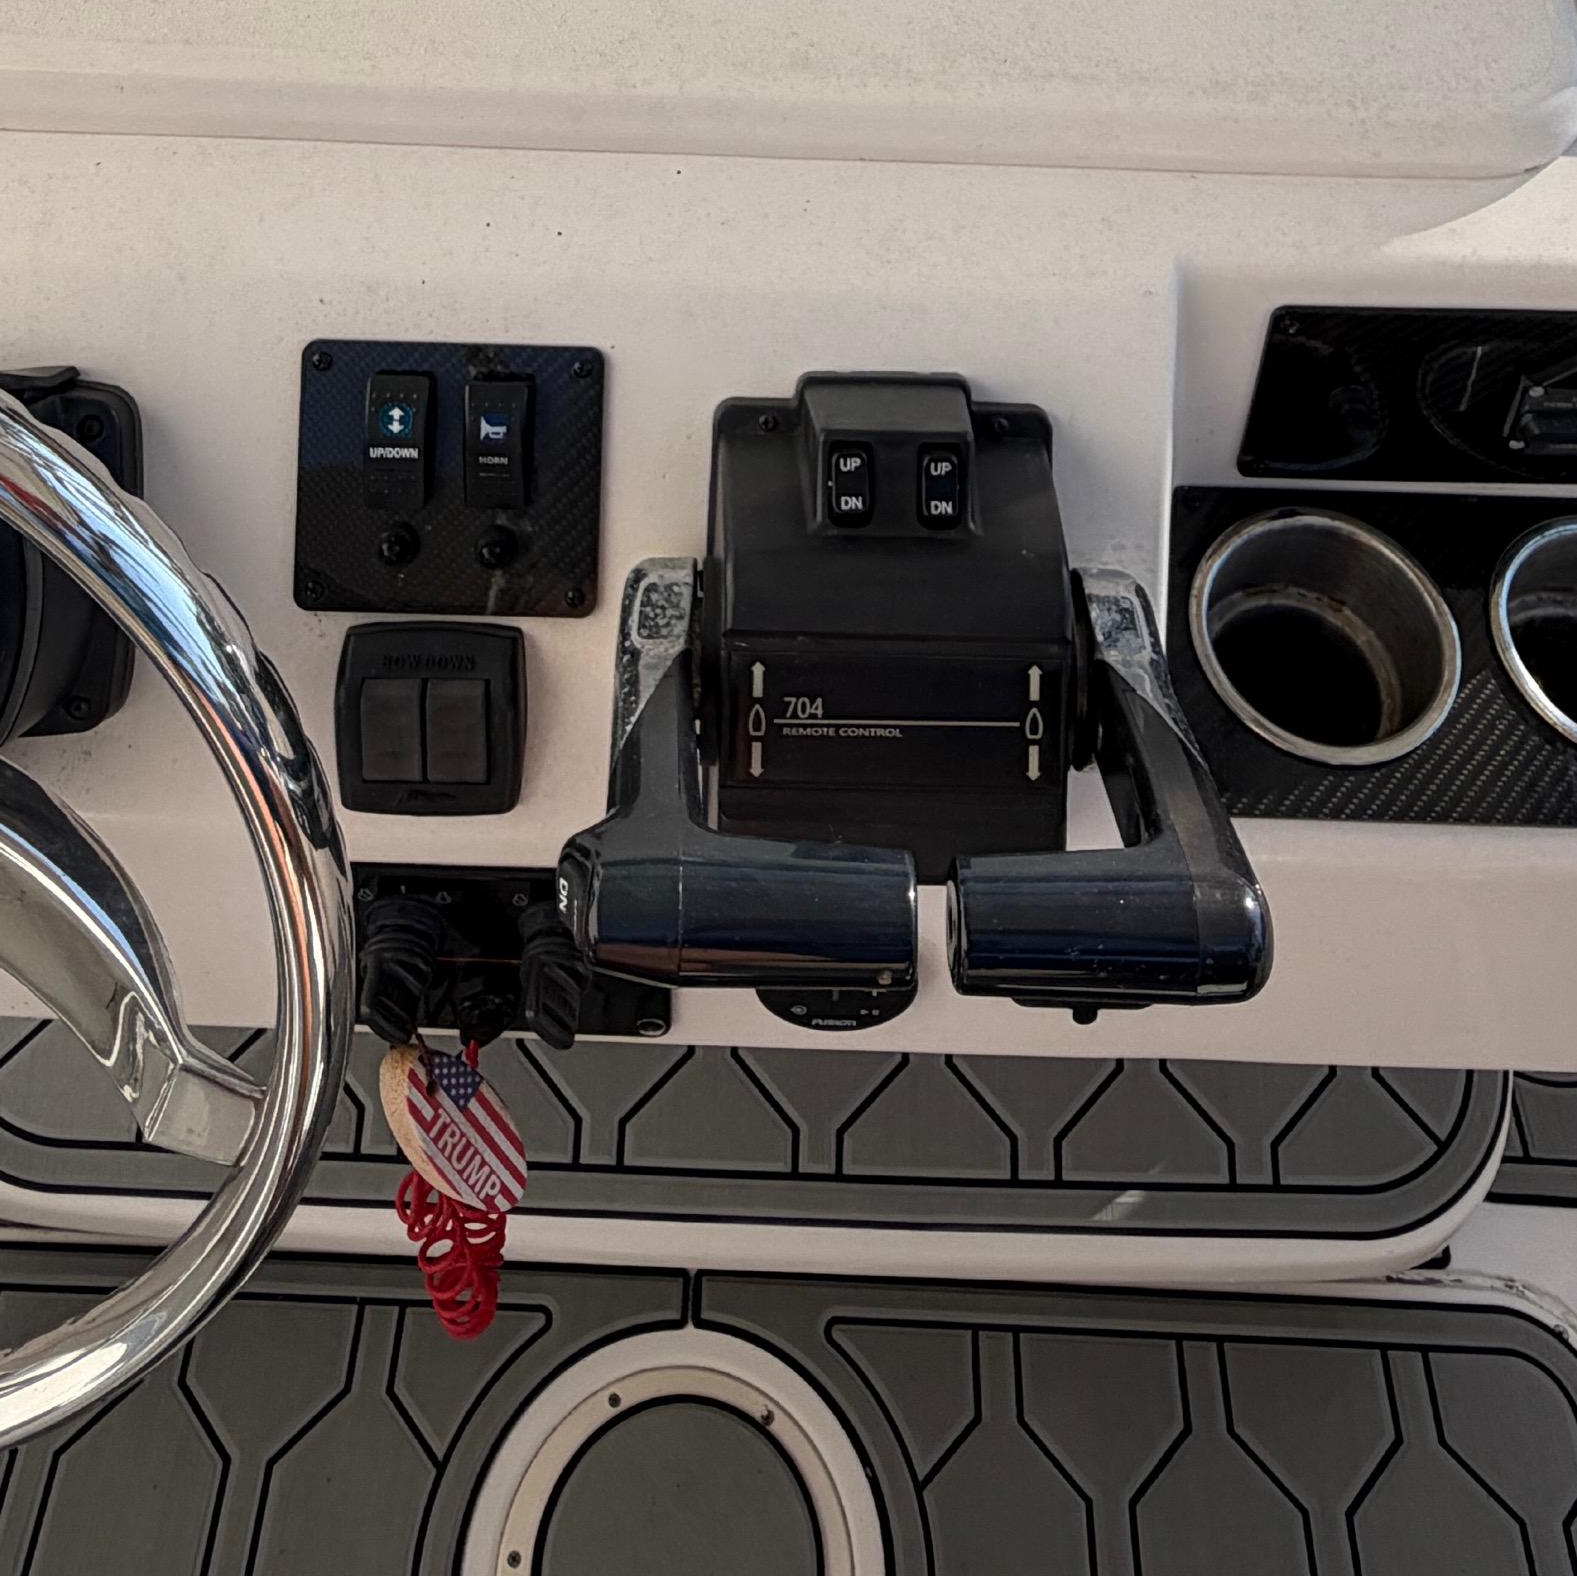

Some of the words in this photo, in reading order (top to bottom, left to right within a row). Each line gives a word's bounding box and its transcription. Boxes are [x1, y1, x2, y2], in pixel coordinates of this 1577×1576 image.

[369, 447, 419, 459] UP/DOWN
[478, 456, 508, 466] HORN
[839, 457, 861, 472] UP
[930, 461, 952, 477] UP
[840, 496, 863, 511] DN
[930, 500, 953, 515] DN
[783, 697, 824, 719] 704
[782, 727, 836, 738] REMOTE
[839, 727, 903, 738] CONTROL
[558, 876, 569, 914] DN
[428, 1109, 502, 1200] TRUMP
